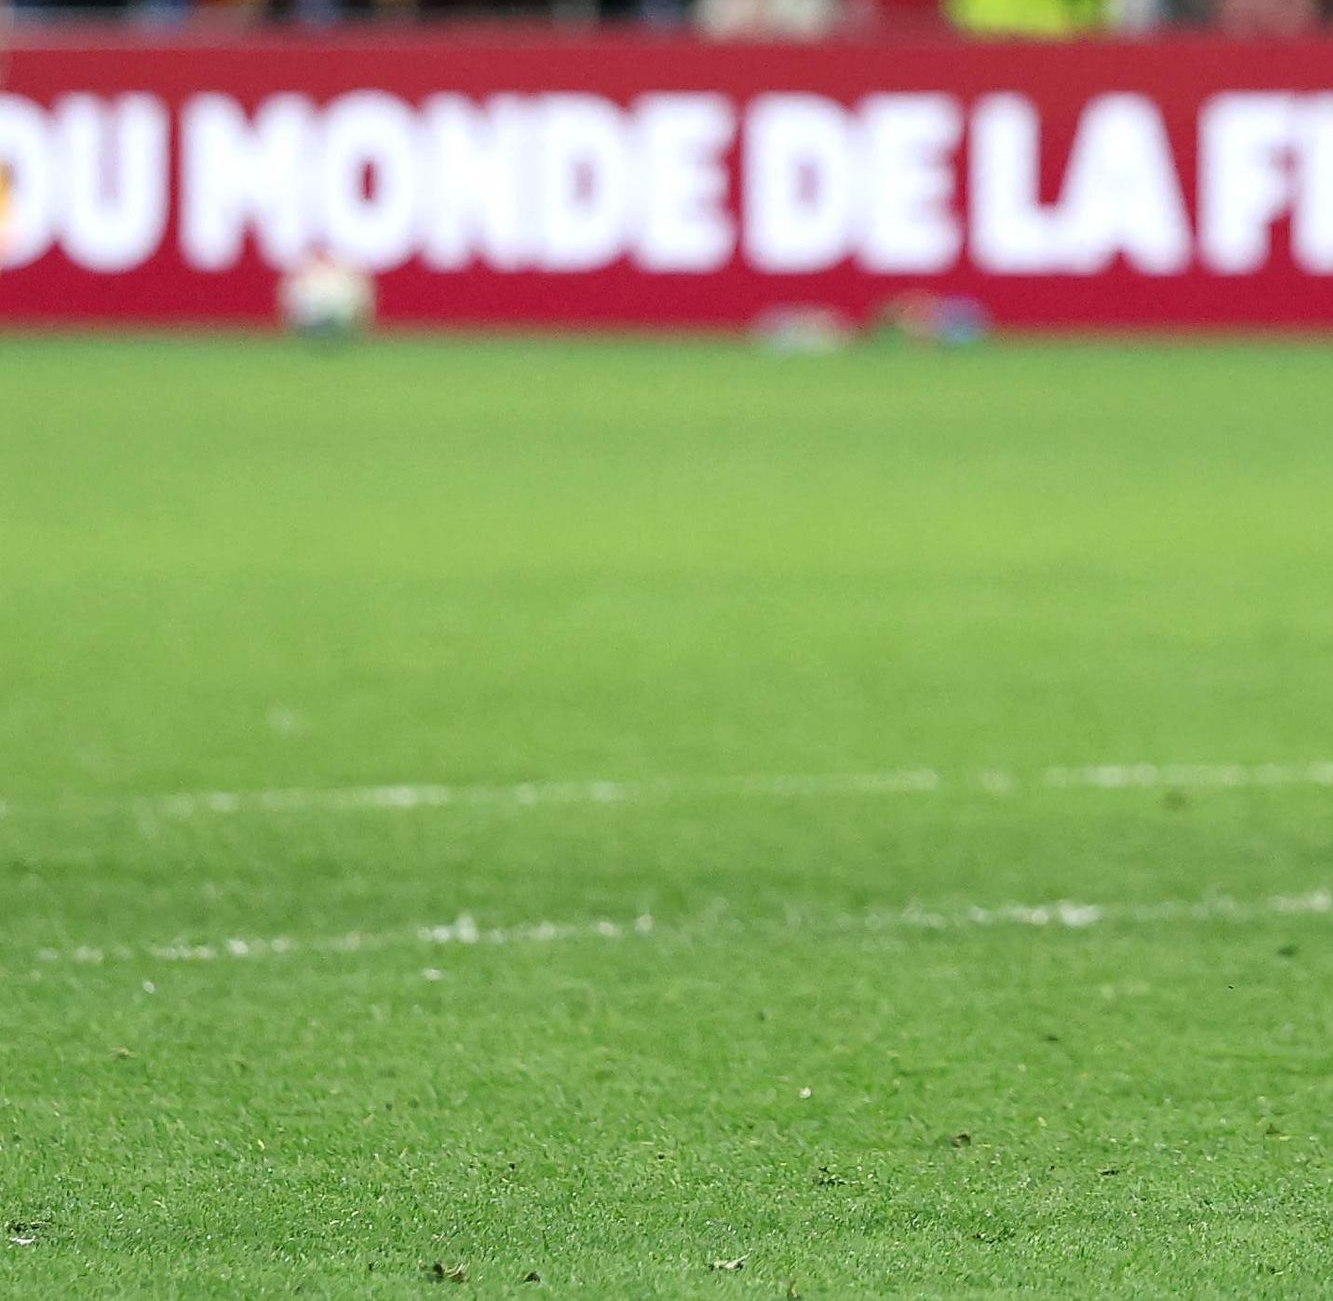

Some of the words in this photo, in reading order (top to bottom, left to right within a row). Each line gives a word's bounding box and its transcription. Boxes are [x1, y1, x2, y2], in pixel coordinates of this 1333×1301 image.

[178, 92, 736, 274] MONDE
[743, 92, 964, 274] DE
[968, 92, 1191, 275] LA
